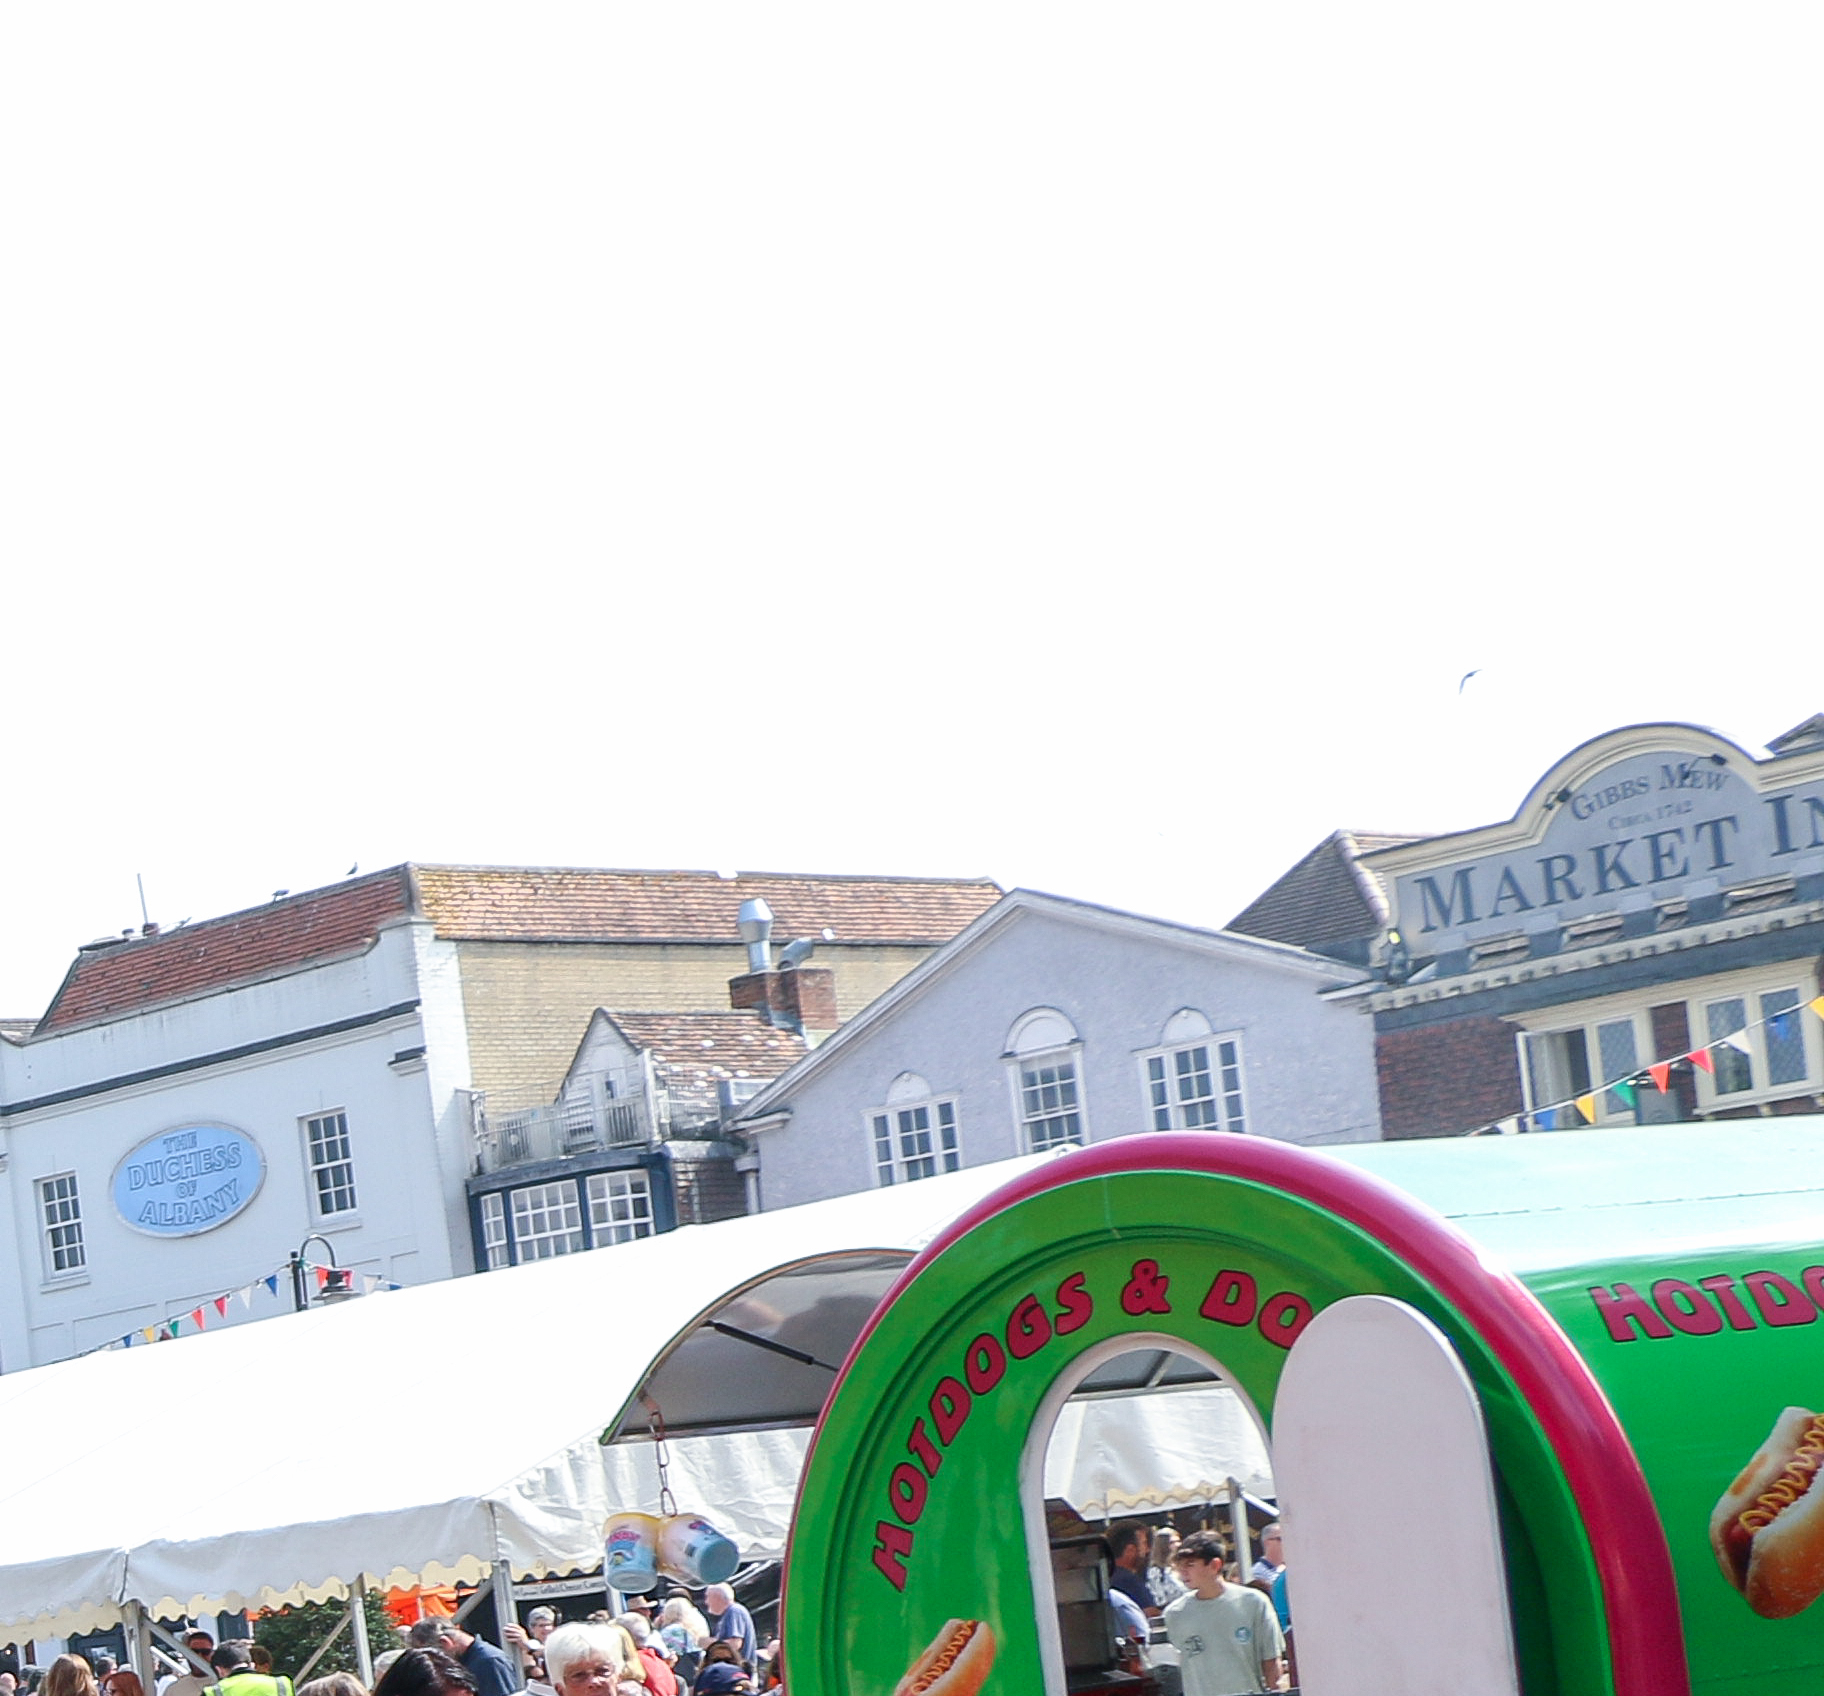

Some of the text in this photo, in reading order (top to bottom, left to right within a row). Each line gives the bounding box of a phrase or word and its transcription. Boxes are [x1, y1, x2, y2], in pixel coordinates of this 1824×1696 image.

[1571, 761, 1729, 820] GIBBS MEW
[1414, 815, 1739, 933] MARKET
[127, 1142, 243, 1190] DUCHESS
[163, 1131, 198, 1155] THE
[138, 1177, 241, 1227] ALBANY
[176, 1179, 197, 1199] OF
[872, 1272, 1093, 1592] HOTDOGS
[1120, 1259, 1171, 1315] &
